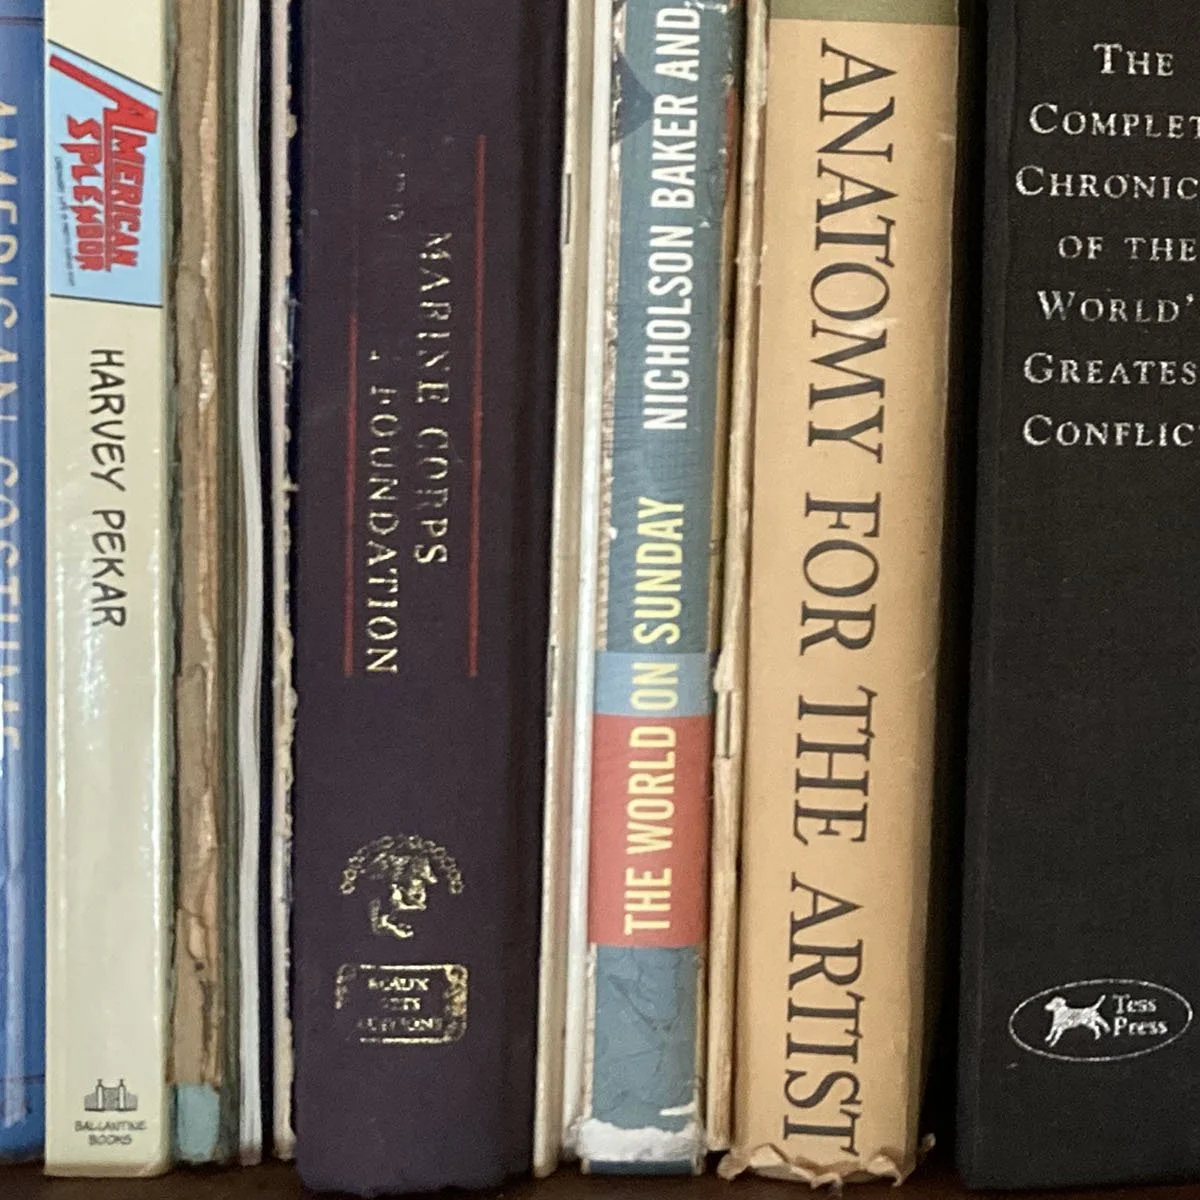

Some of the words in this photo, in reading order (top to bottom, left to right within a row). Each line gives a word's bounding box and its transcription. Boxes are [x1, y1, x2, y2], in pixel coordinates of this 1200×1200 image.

[655, 7, 702, 85] AND
[49, 54, 158, 273] AMERICAN
[60, 114, 104, 272] SPLENDOR
[651, 94, 699, 209] BAKER
[415, 231, 453, 405] MARINE
[808, 38, 899, 464] ANATOMY
[1058, 235, 1104, 259] OF
[1124, 237, 1197, 262] THE
[642, 225, 694, 431] NICHOLSON
[89, 349, 126, 493] HARVEY
[366, 383, 401, 674] FOUNDATION
[414, 427, 451, 565] CORPS
[91, 509, 127, 628] PEKAR
[632, 496, 684, 645] SUNDAY
[799, 492, 882, 657] FOR
[630, 661, 680, 711] ON
[626, 725, 678, 855] WORLD
[792, 685, 879, 846] THE
[624, 867, 672, 936] THE
[783, 872, 866, 1158] ARTIST
[1112, 993, 1158, 1014] Tess
[1113, 1016, 1168, 1036] Press
[88, 1134, 132, 1145] BOOKS
